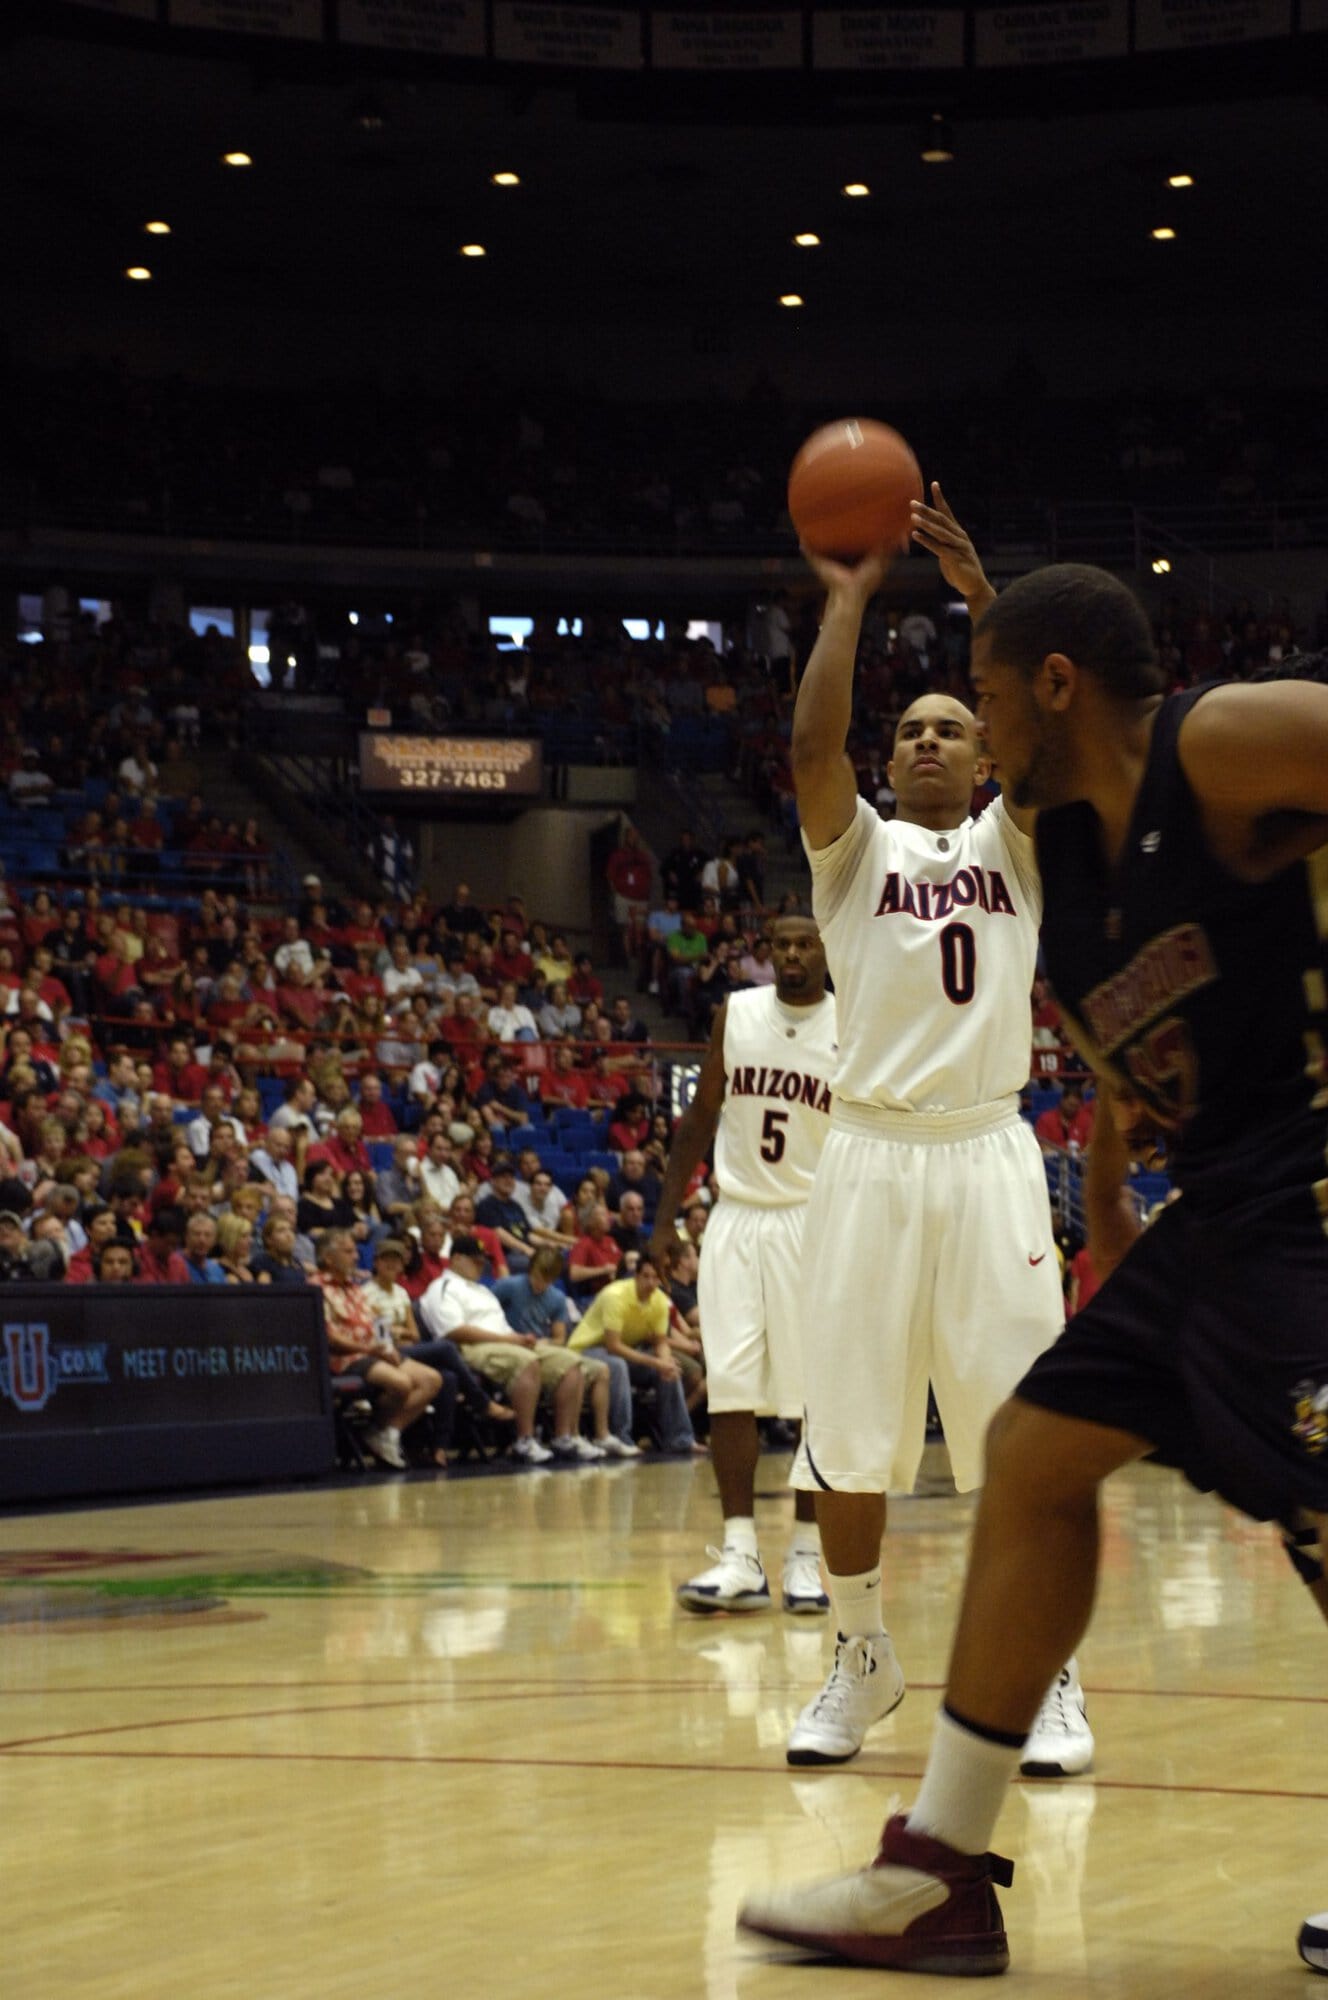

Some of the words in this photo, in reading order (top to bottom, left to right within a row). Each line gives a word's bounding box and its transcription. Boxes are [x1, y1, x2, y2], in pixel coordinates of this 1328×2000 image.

[399, 770, 507, 789] 327-7463
[939, 922, 976, 1006] 0
[731, 1066, 833, 1115] ARIZONA
[760, 1109, 789, 1164] 5
[121, 1345, 168, 1379] MEET
[172, 1345, 231, 1377] OTHER
[233, 1344, 310, 1376] FANATICS
